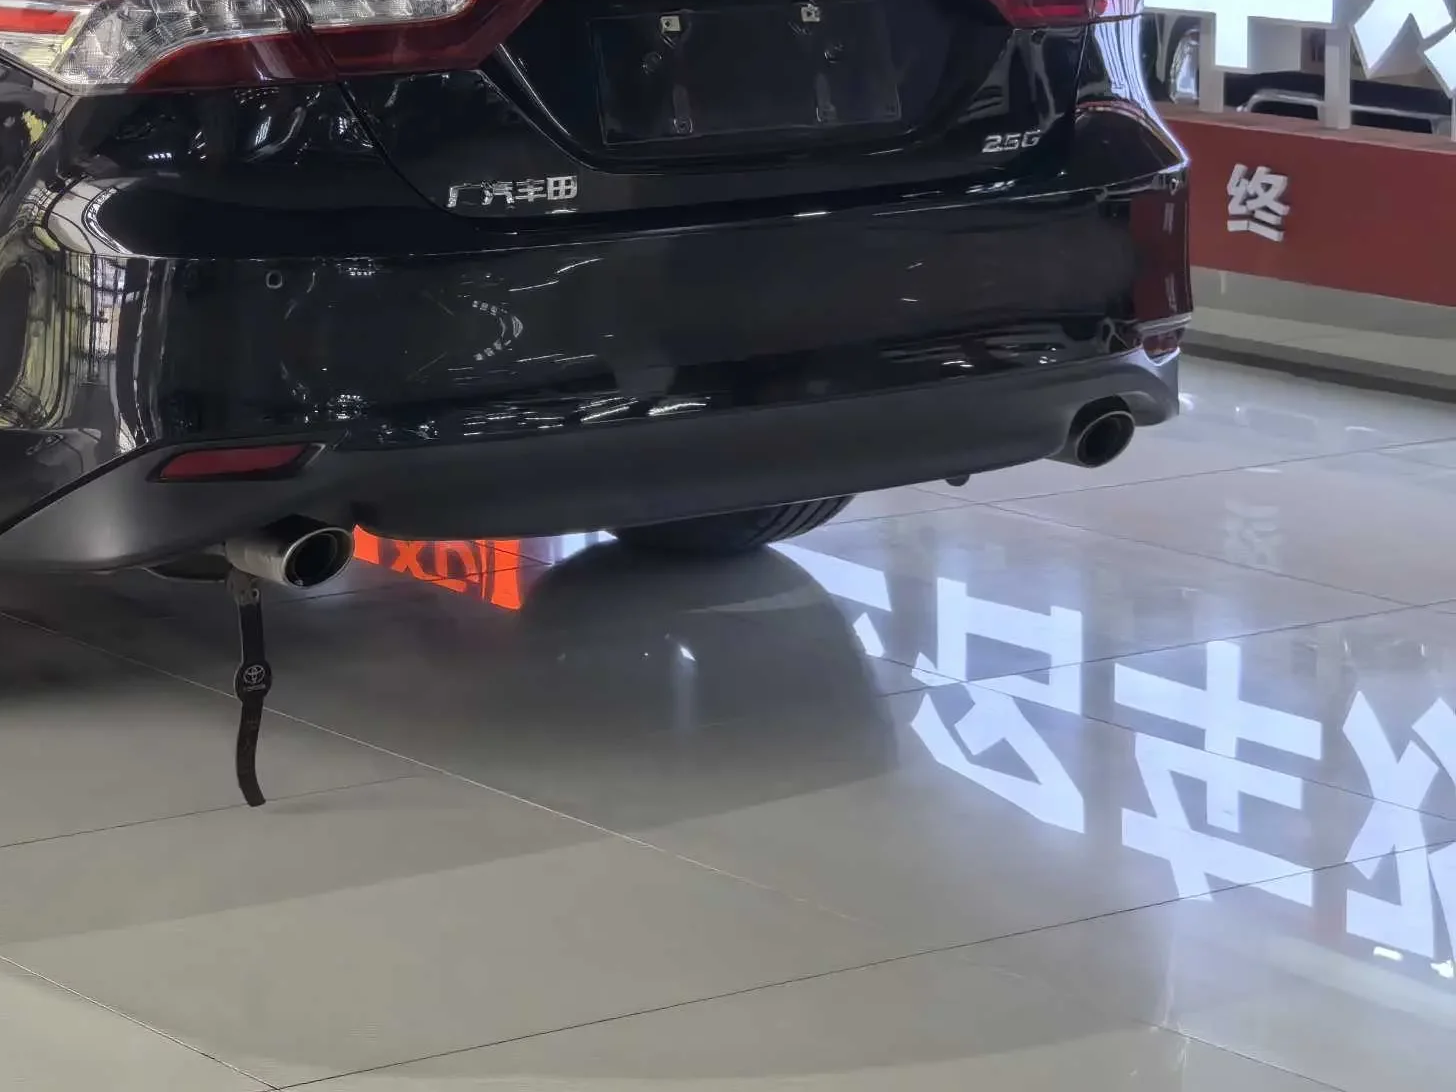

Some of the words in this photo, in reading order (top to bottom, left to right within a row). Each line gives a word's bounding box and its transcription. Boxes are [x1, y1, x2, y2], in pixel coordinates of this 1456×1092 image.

[445, 174, 579, 209] 广汽丰田
[1226, 163, 1291, 242] 终
